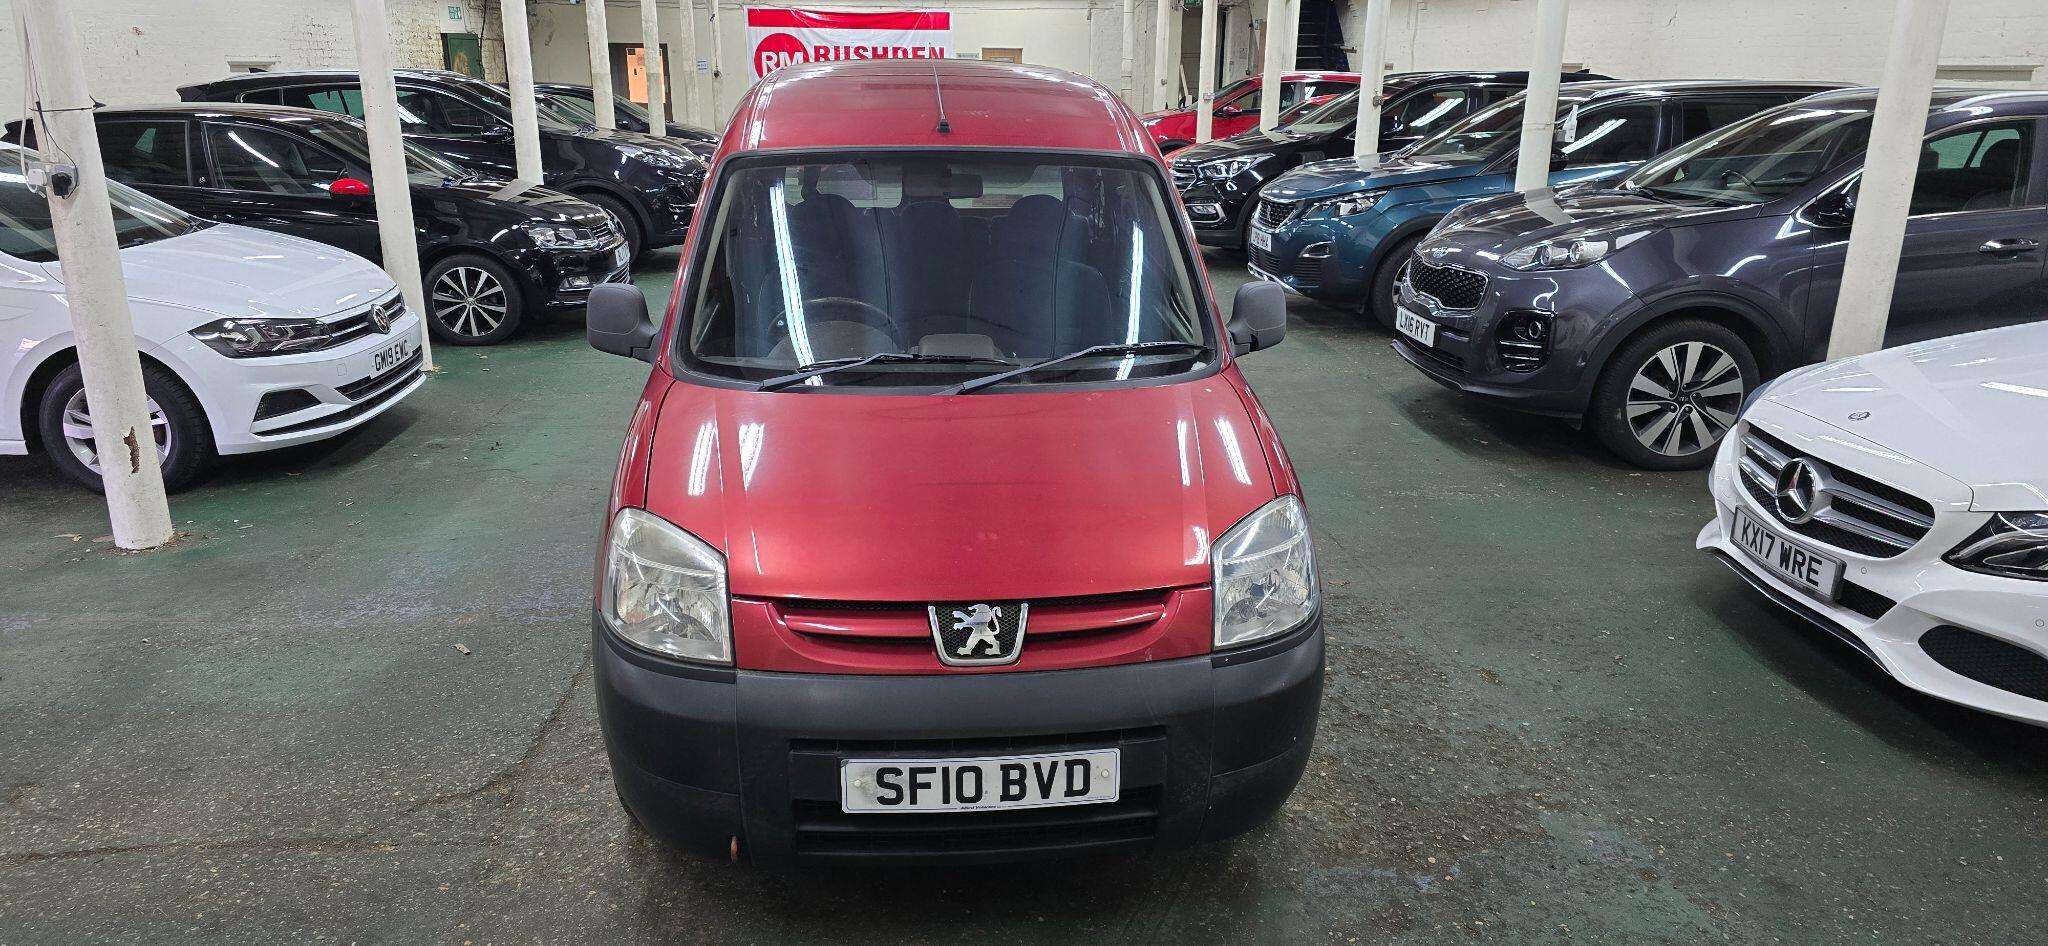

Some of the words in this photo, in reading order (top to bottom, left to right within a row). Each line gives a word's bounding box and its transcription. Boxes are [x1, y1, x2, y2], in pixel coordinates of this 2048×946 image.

[761, 51, 804, 76] RM
[375, 348, 393, 371] GM19
[1742, 517, 1775, 559] KX17
[1780, 541, 1822, 587] WRE
[876, 765, 983, 806] SF10
[999, 758, 1091, 802] BVD
